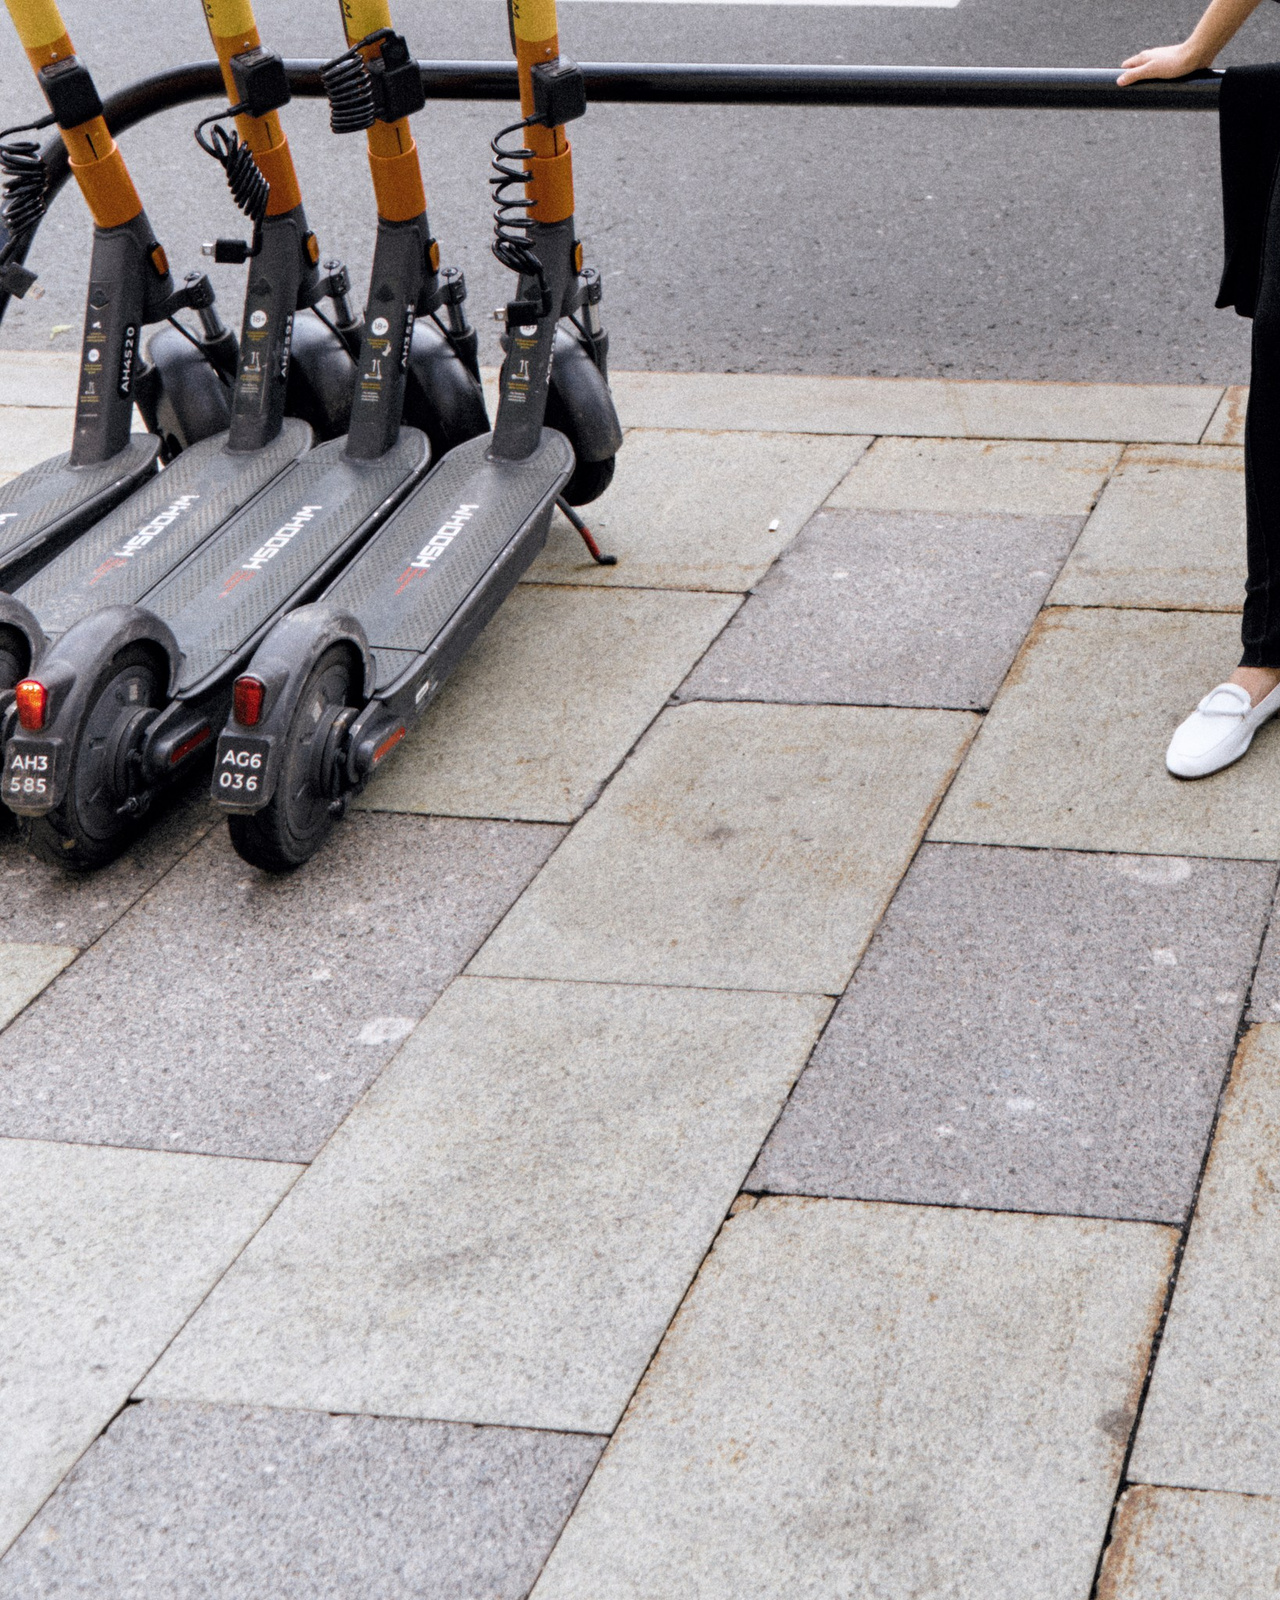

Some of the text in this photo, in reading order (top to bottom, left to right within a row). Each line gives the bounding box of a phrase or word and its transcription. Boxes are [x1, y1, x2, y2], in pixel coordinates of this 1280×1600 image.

[120, 326, 136, 392] AH4520
[114, 495, 200, 557] WHOOSH
[242, 505, 322, 569] WHOOSH
[411, 504, 480, 567] WHOOSH
[11, 755, 48, 771] AH3
[222, 750, 262, 768] AG6
[10, 777, 47, 793] 585
[219, 772, 258, 791] 036
